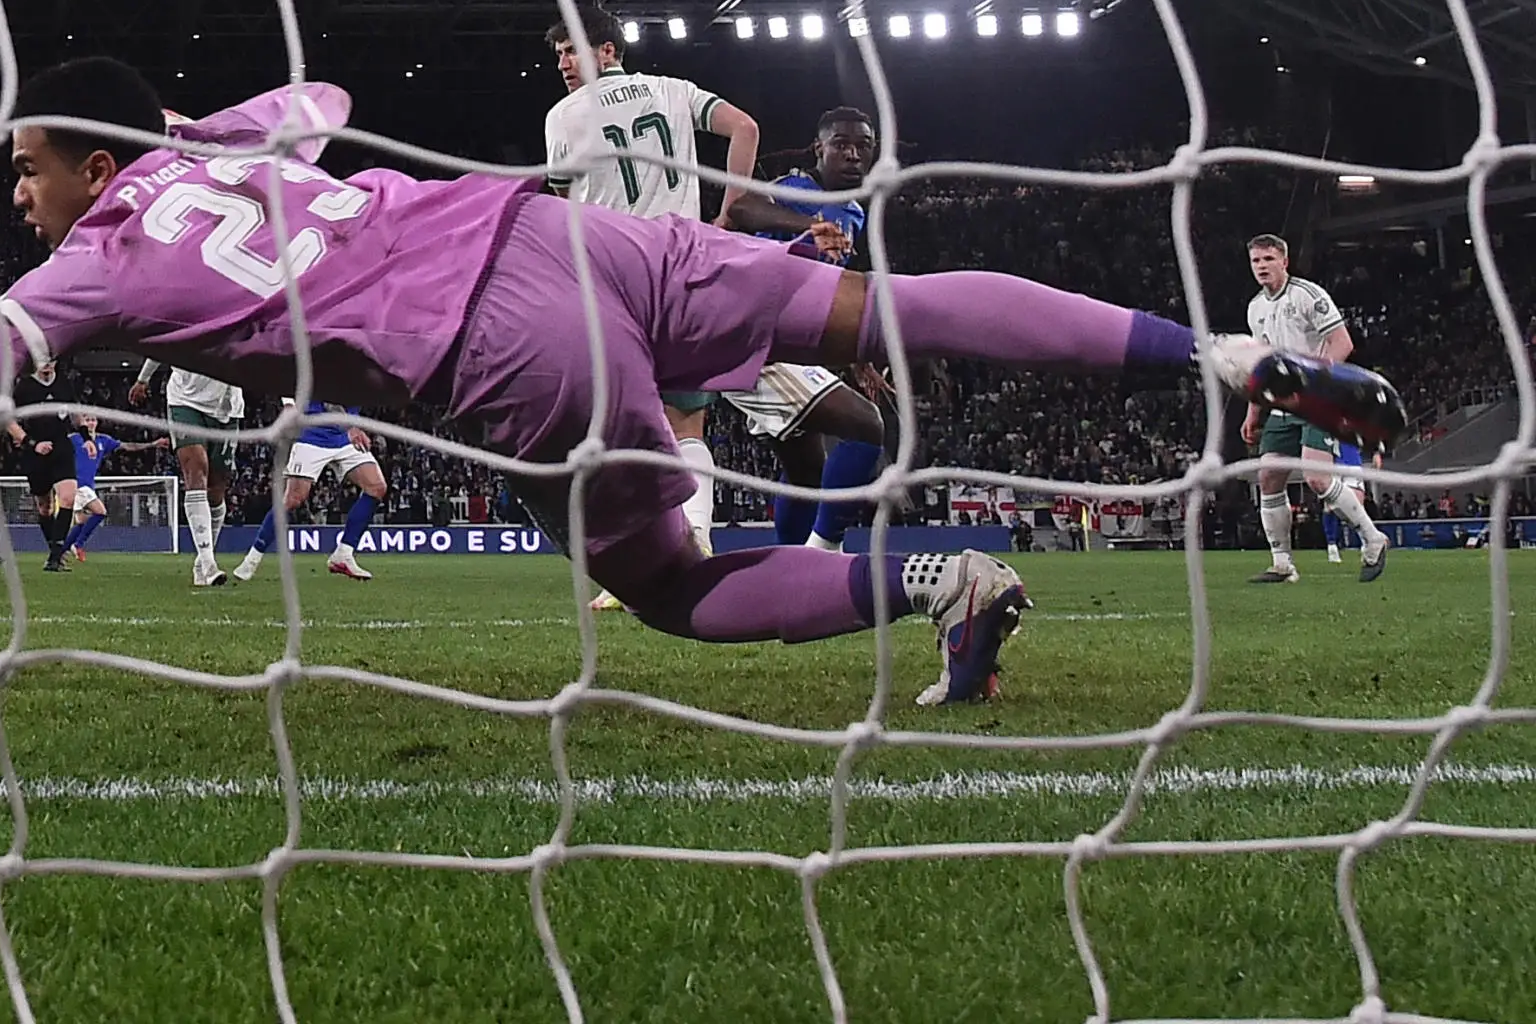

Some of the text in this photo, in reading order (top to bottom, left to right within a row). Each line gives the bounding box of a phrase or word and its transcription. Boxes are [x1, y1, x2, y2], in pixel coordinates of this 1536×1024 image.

[602, 112, 679, 205] 17
[288, 530, 320, 551] IN
[468, 530, 484, 551] E
[500, 530, 541, 552] SU
